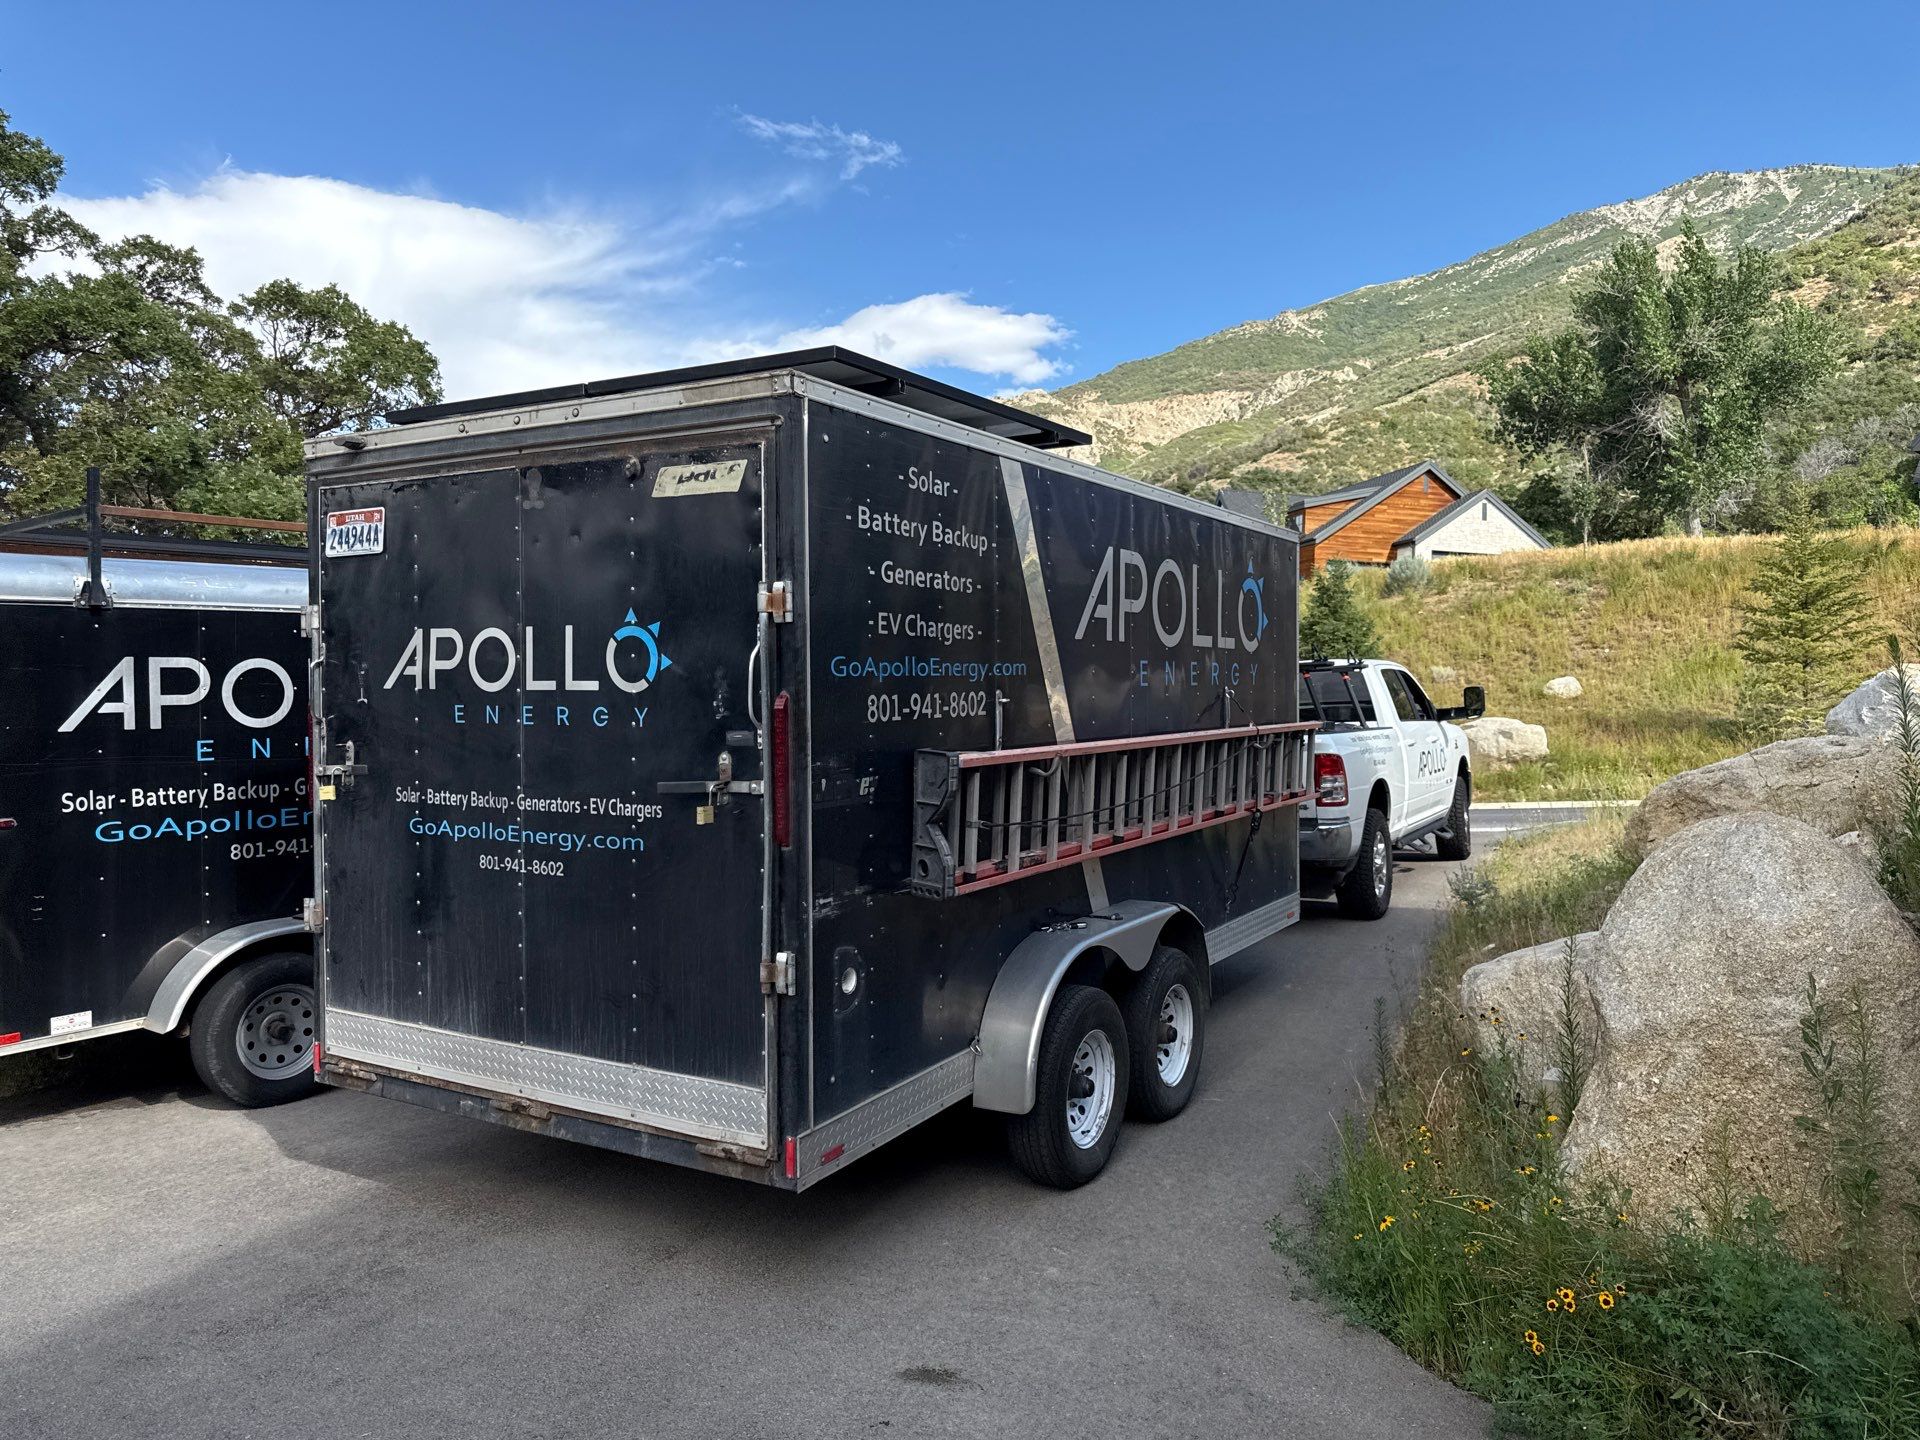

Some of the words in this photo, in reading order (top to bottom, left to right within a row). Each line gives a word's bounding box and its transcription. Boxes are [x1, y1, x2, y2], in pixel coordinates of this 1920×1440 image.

[908, 466, 950, 497] Solar
[345, 513, 365, 522] UTAH
[858, 505, 928, 546] Battery
[932, 521, 988, 557] Backup
[330, 524, 379, 550] 244944A
[881, 561, 973, 593] Generators
[1074, 546, 1263, 653] APOLLO
[878, 612, 902, 635] EV
[905, 614, 974, 645] Chargers
[383, 625, 659, 693] APOLLO
[830, 656, 1027, 682] GoApolloEnergy.com
[1140, 660, 1258, 687] ENERGY
[454, 704, 648, 727] ENERGY
[867, 691, 987, 723] 801-941-8602
[1418, 748, 1446, 778] APOLLO
[61, 790, 116, 813] Solar
[131, 787, 208, 808] Battery
[214, 780, 280, 803] Backup
[395, 787, 420, 803] Solar
[427, 788, 468, 811] Battery
[471, 791, 508, 813] Backup
[517, 794, 580, 814] Generators
[590, 798, 605, 815] EV
[608, 799, 662, 822] Chargers
[409, 818, 644, 852] GoApolloEnergy.com
[479, 855, 564, 877] 801-941-8602
